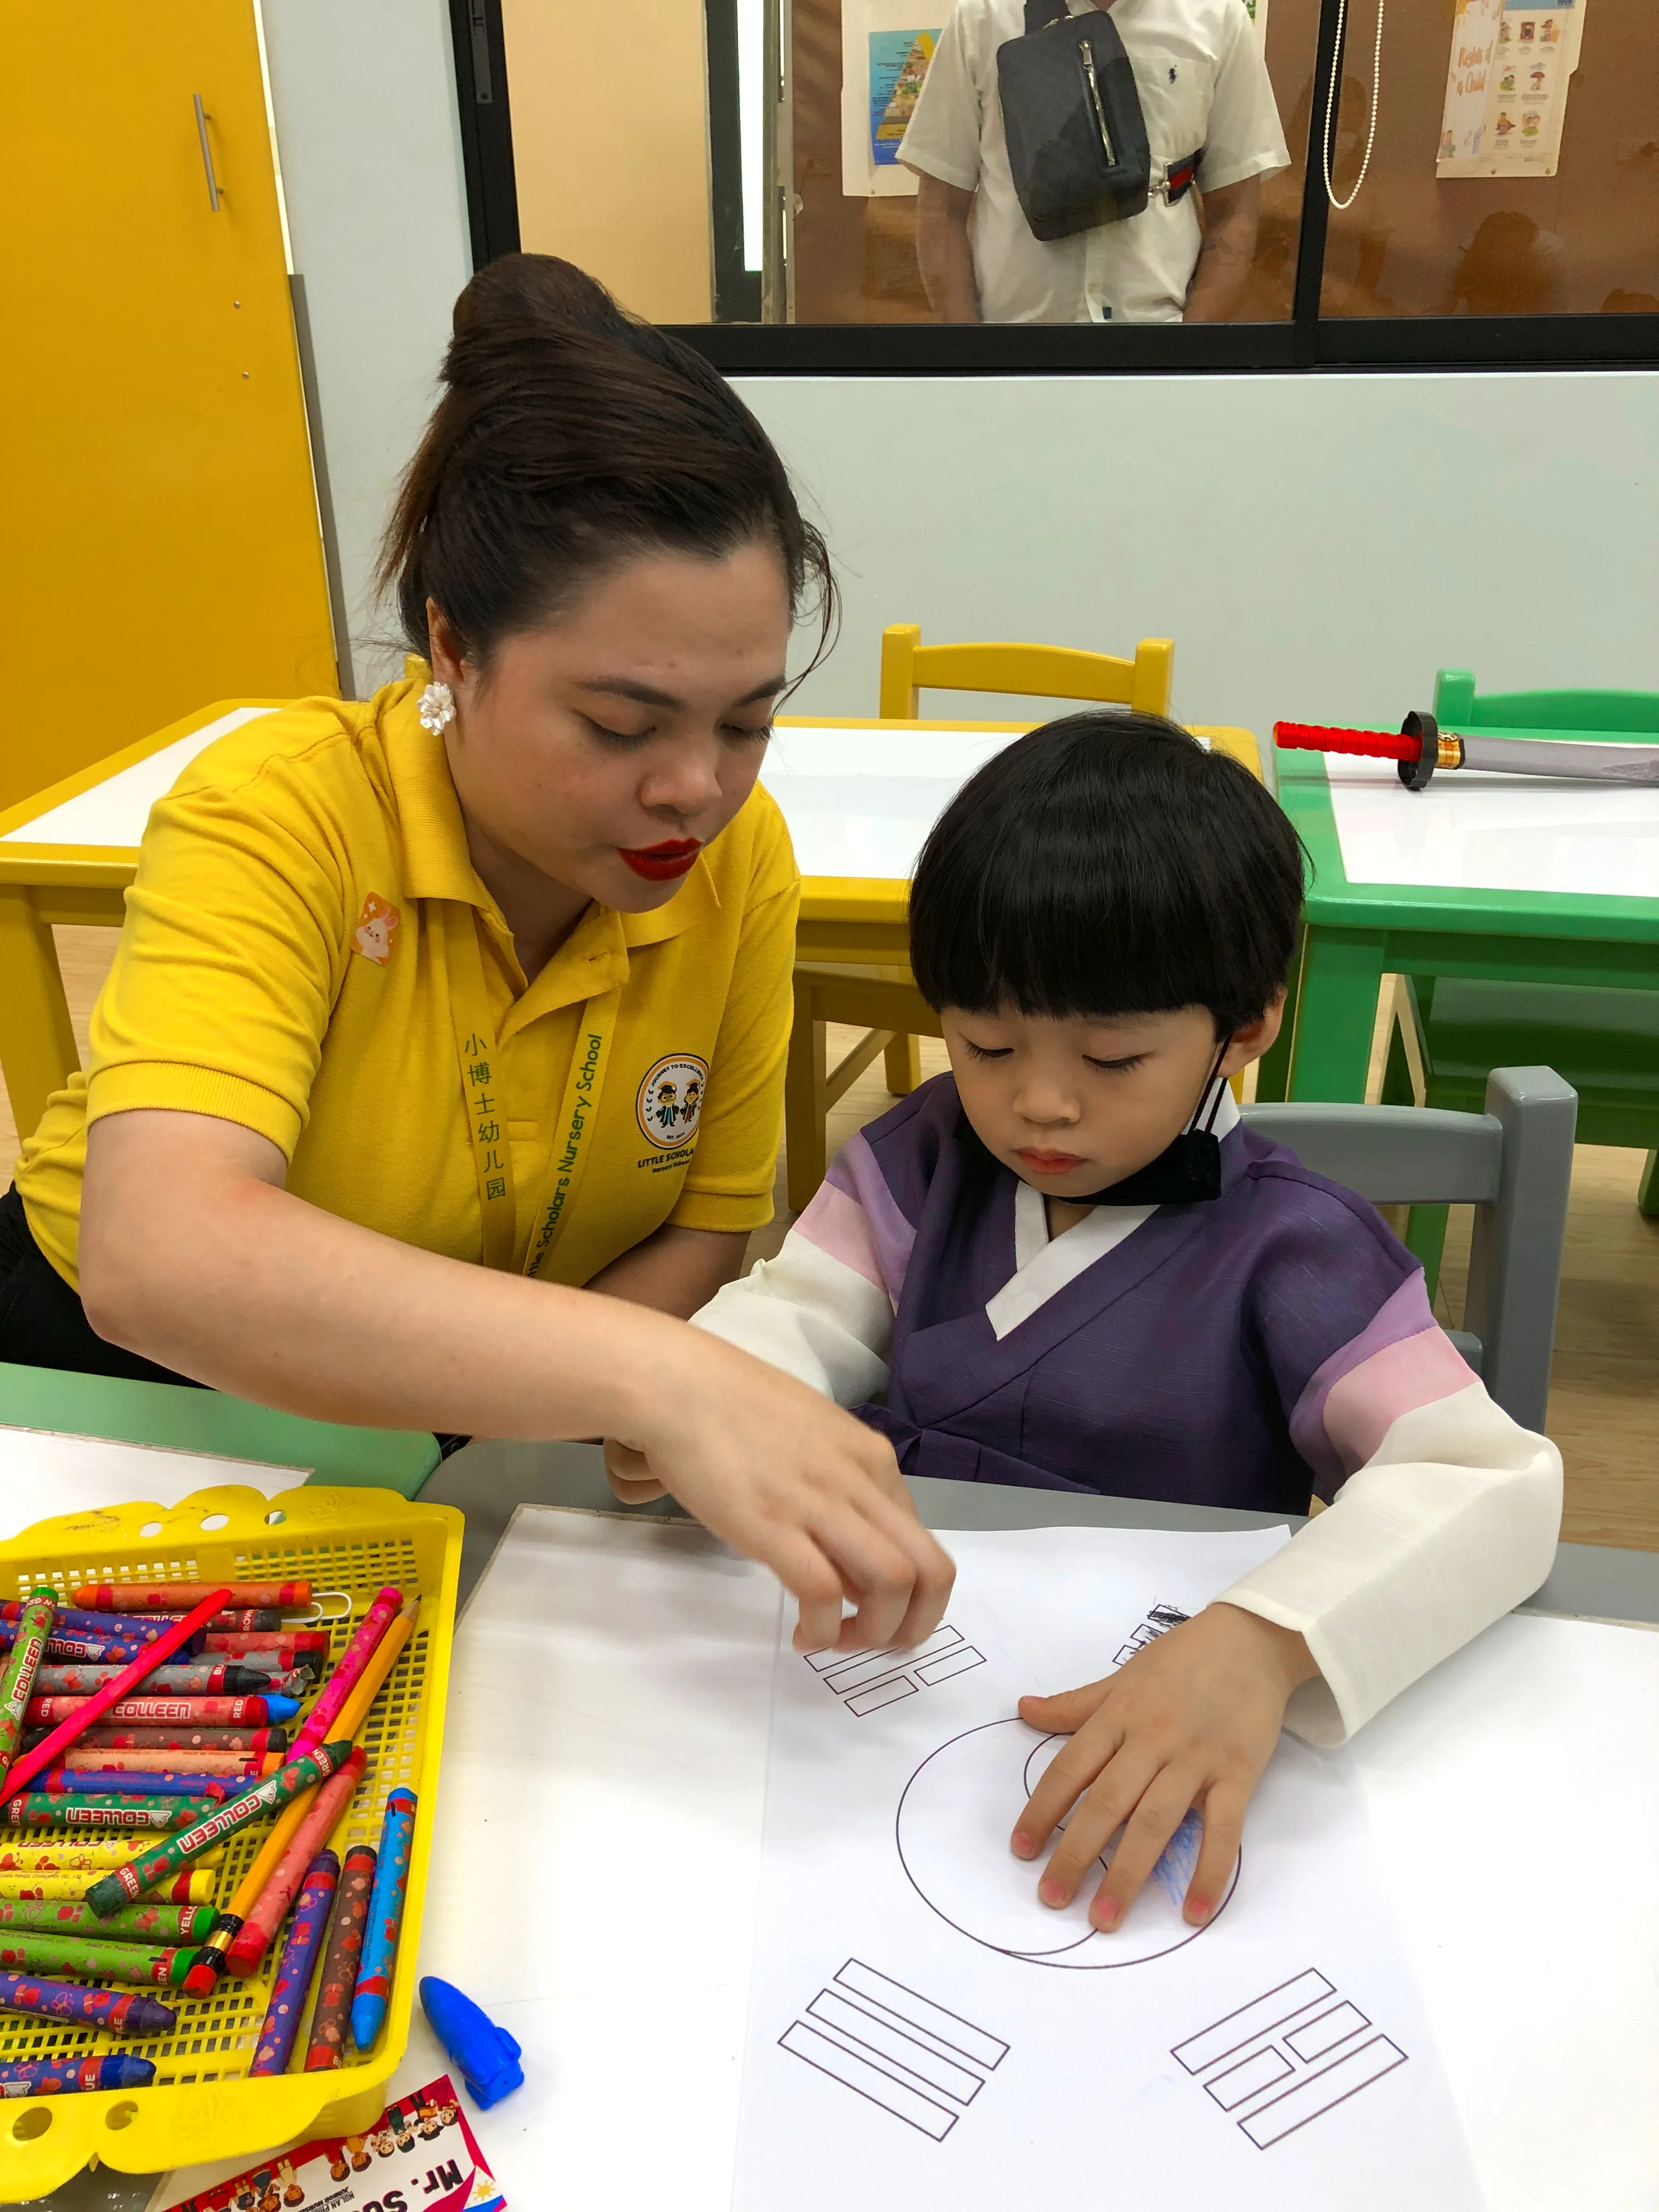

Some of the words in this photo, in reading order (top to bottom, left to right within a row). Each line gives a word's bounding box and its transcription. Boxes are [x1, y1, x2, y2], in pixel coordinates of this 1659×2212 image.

[576, 1034, 602, 1092] School
[651, 1066, 669, 1087] JOURNEY
[464, 1034, 506, 1201] 小博士幼儿园
[557, 1095, 592, 1173] Nursery
[638, 1155, 664, 1168] LITTLE
[666, 1148, 693, 1162] SCHOLA
[673, 1159, 690, 1167] School
[536, 1177, 570, 1248] Scholars
[528, 1251, 545, 1277] ttle
[243, 1610, 255, 1630] ROW
[12, 1638, 43, 1702] COLLEEN
[41, 1698, 53, 1717] RED
[113, 1702, 190, 1718] COLLEEN
[233, 1699, 243, 1718] RED
[312, 1749, 332, 1777] GREEN
[66, 1808, 150, 1826] COLLEEN
[177, 1792, 262, 1854] COLLEEN
[120, 1867, 139, 1898] GREEN
[180, 1905, 198, 1935] YELLO
[114, 1945, 143, 1954] THAILAND
[411, 2159, 464, 2193] Mr.
[324, 2187, 349, 2203] JUNIOR
[331, 2192, 354, 2209] NOLAN
